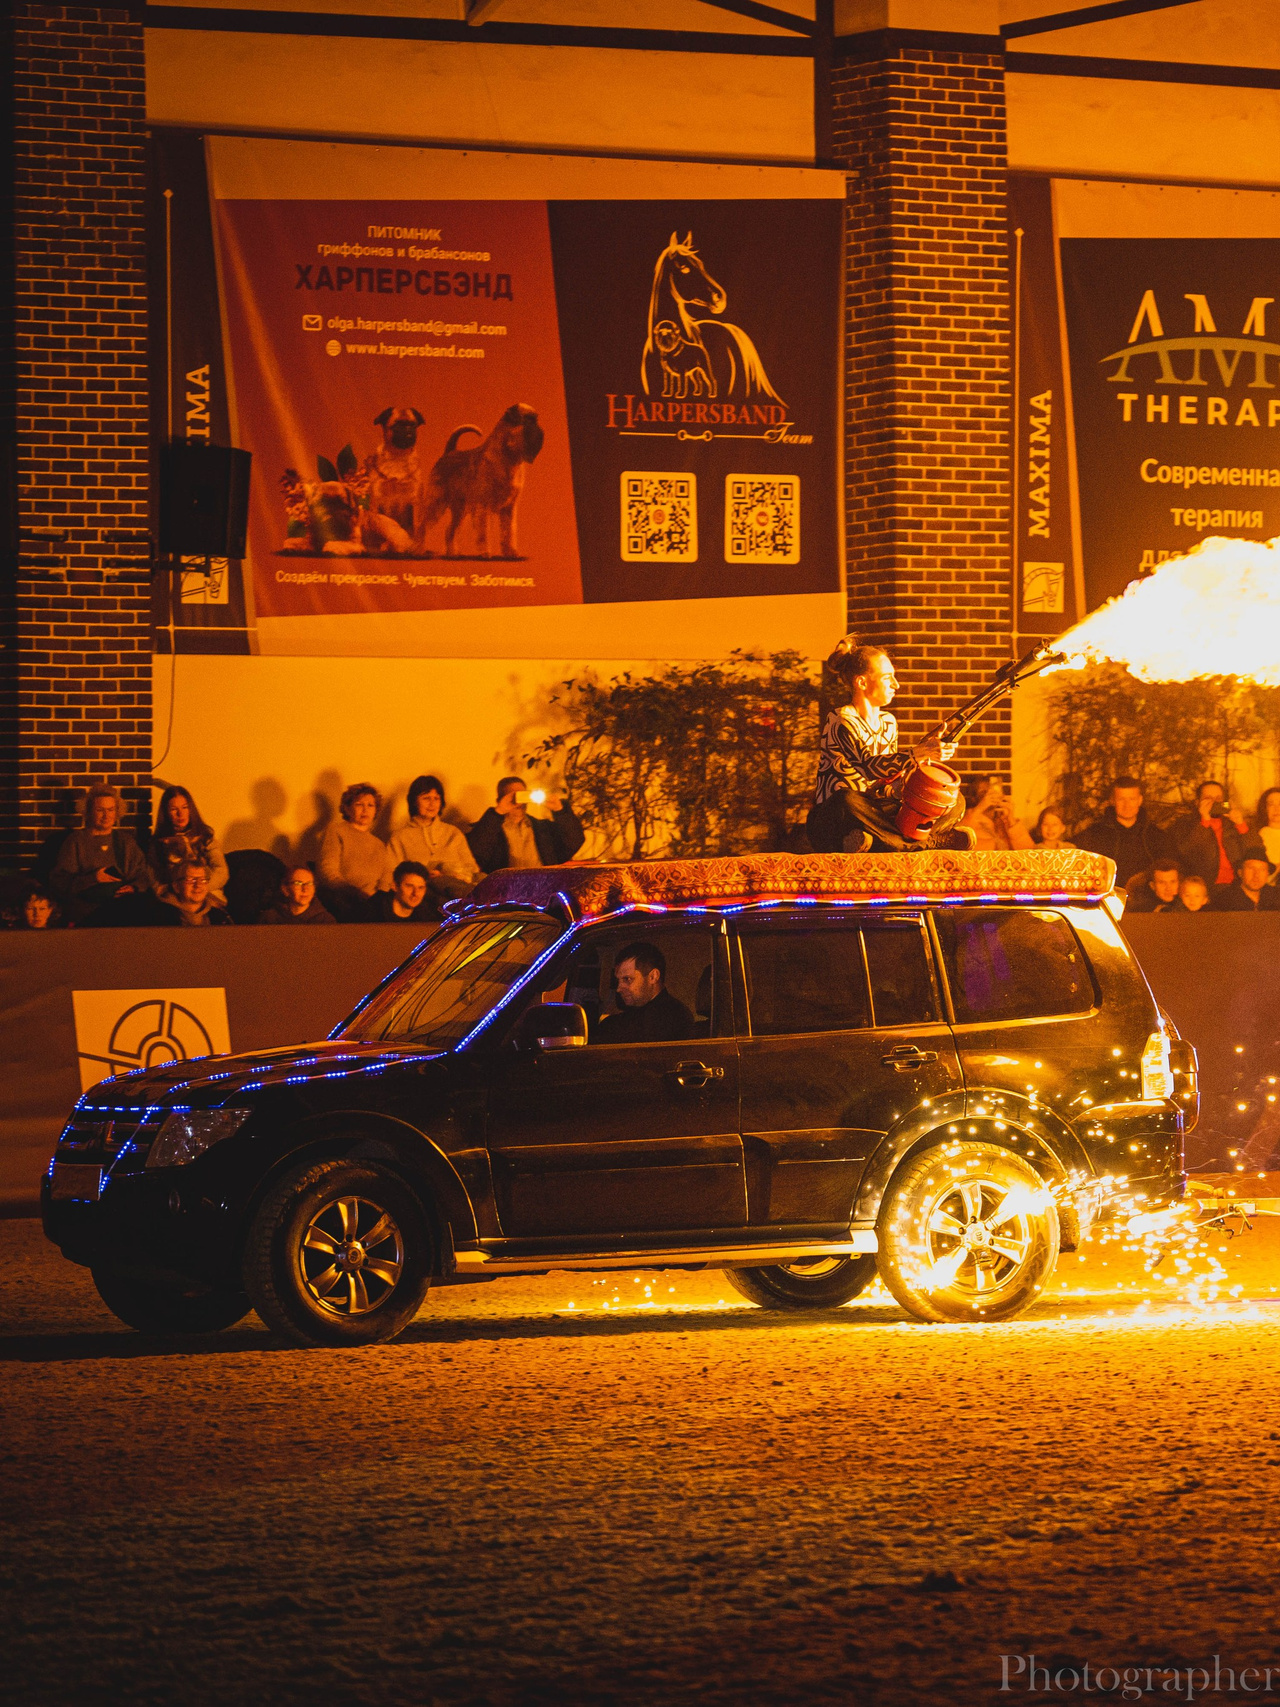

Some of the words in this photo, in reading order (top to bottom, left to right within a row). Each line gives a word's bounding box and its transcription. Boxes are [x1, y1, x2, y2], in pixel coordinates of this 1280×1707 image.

[367, 225, 442, 241] ПИТОМНИК
[317, 242, 394, 258] гриффонов
[397, 248, 405, 257] и
[408, 246, 491, 262] брабансонов
[295, 264, 513, 301] ХАРПЕРСБЭНД
[327, 316, 507, 336] olga.harpersband@gmail.com
[346, 342, 485, 359] www.harpersband.com
[764, 422, 813, 444] Team
[1028, 390, 1052, 538] MAXIMA
[1170, 508, 1263, 531] терапия
[275, 570, 328, 585] Создаём
